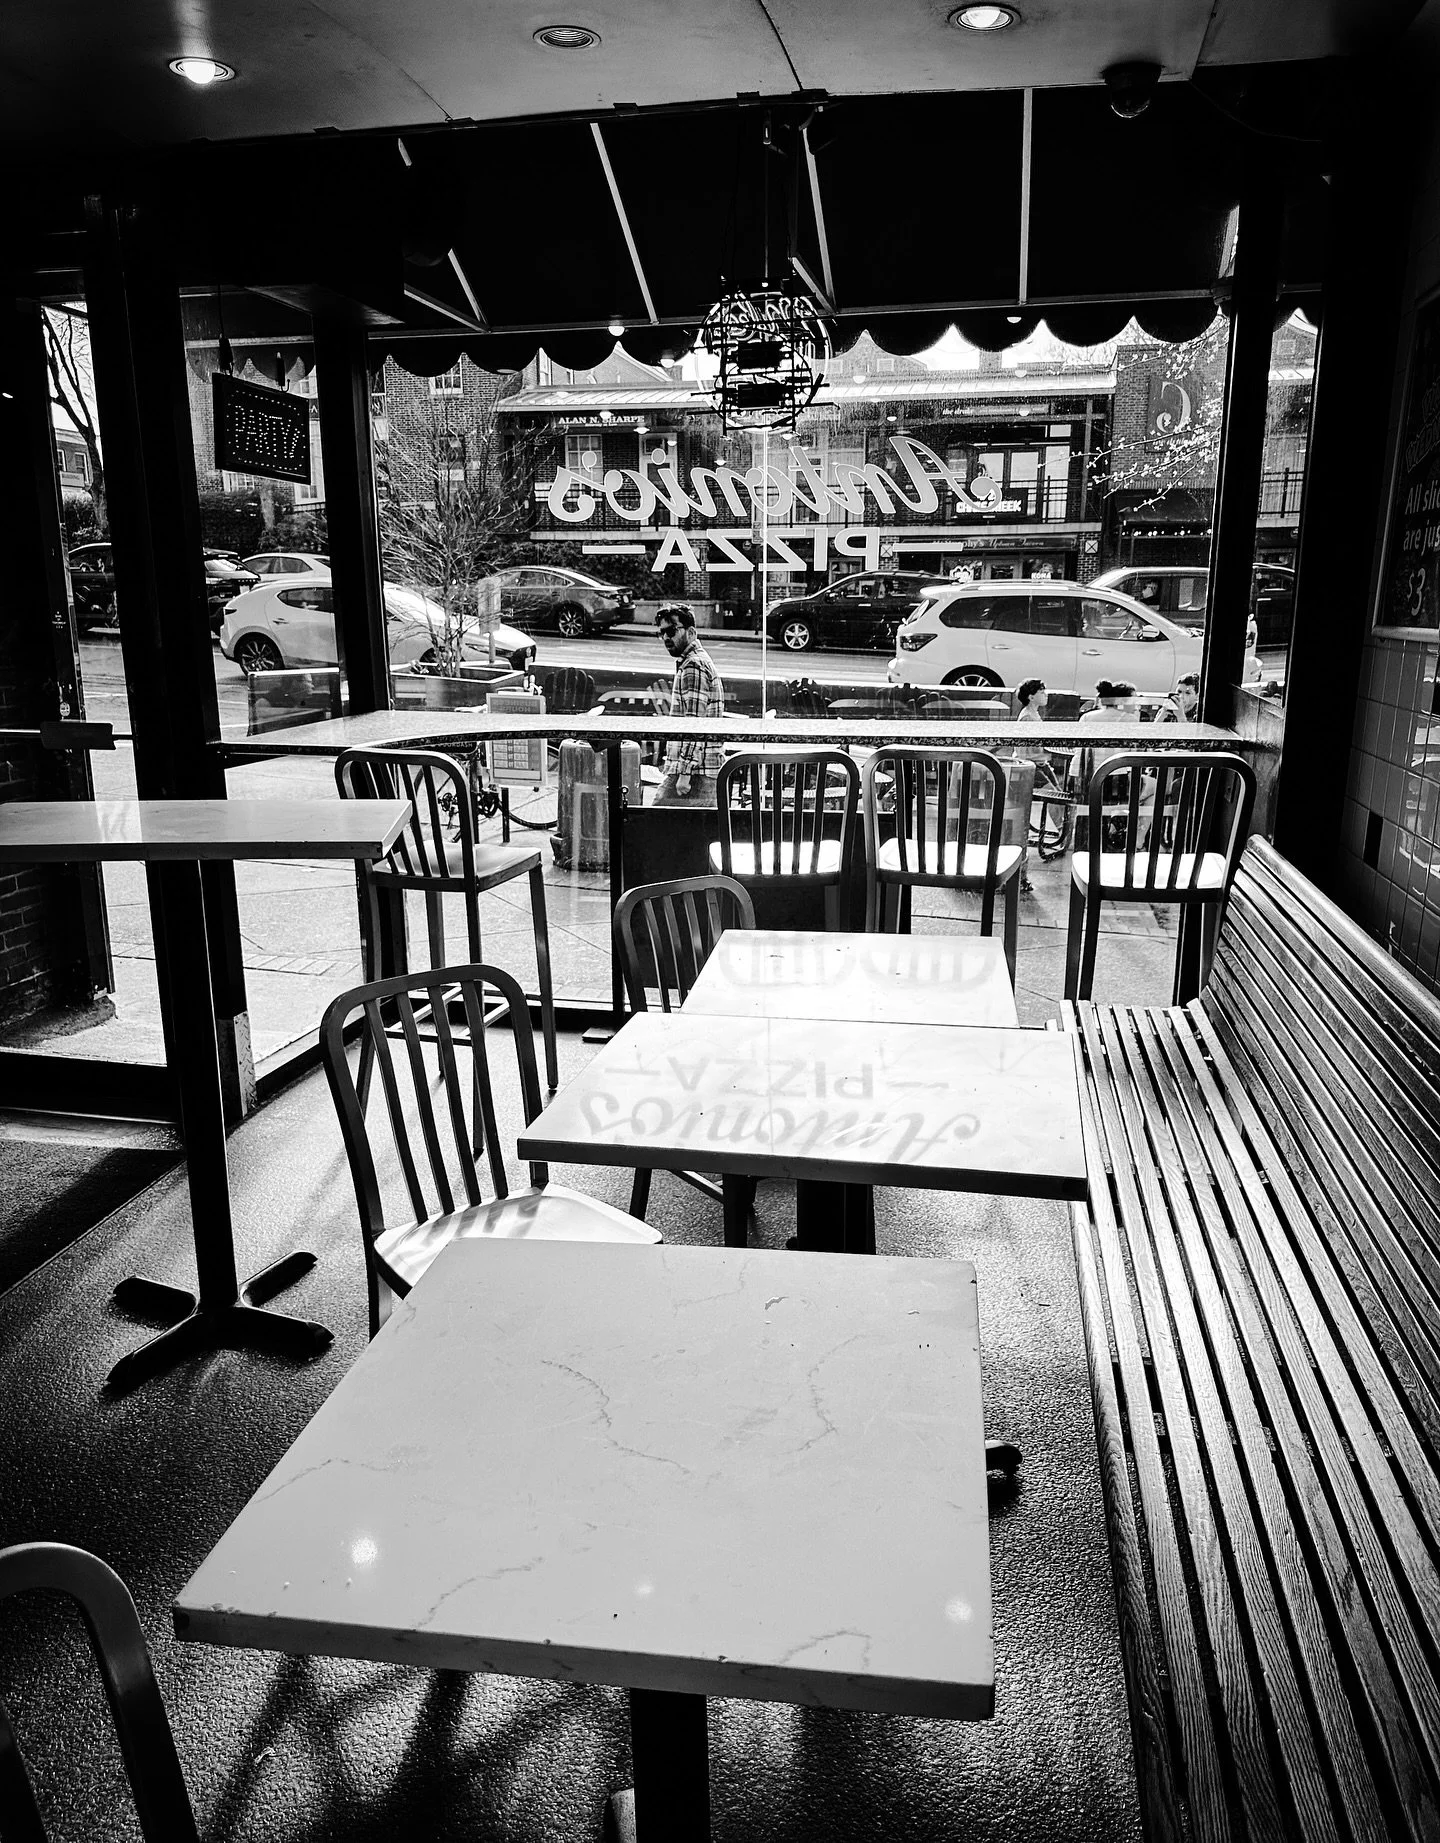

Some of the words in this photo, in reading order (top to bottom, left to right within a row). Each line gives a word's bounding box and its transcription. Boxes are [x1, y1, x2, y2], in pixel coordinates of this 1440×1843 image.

[558, 416, 587, 425] ALAN
[589, 416, 600, 424] N.
[1404, 482, 1423, 516] All
[1403, 528, 1421, 551] are
